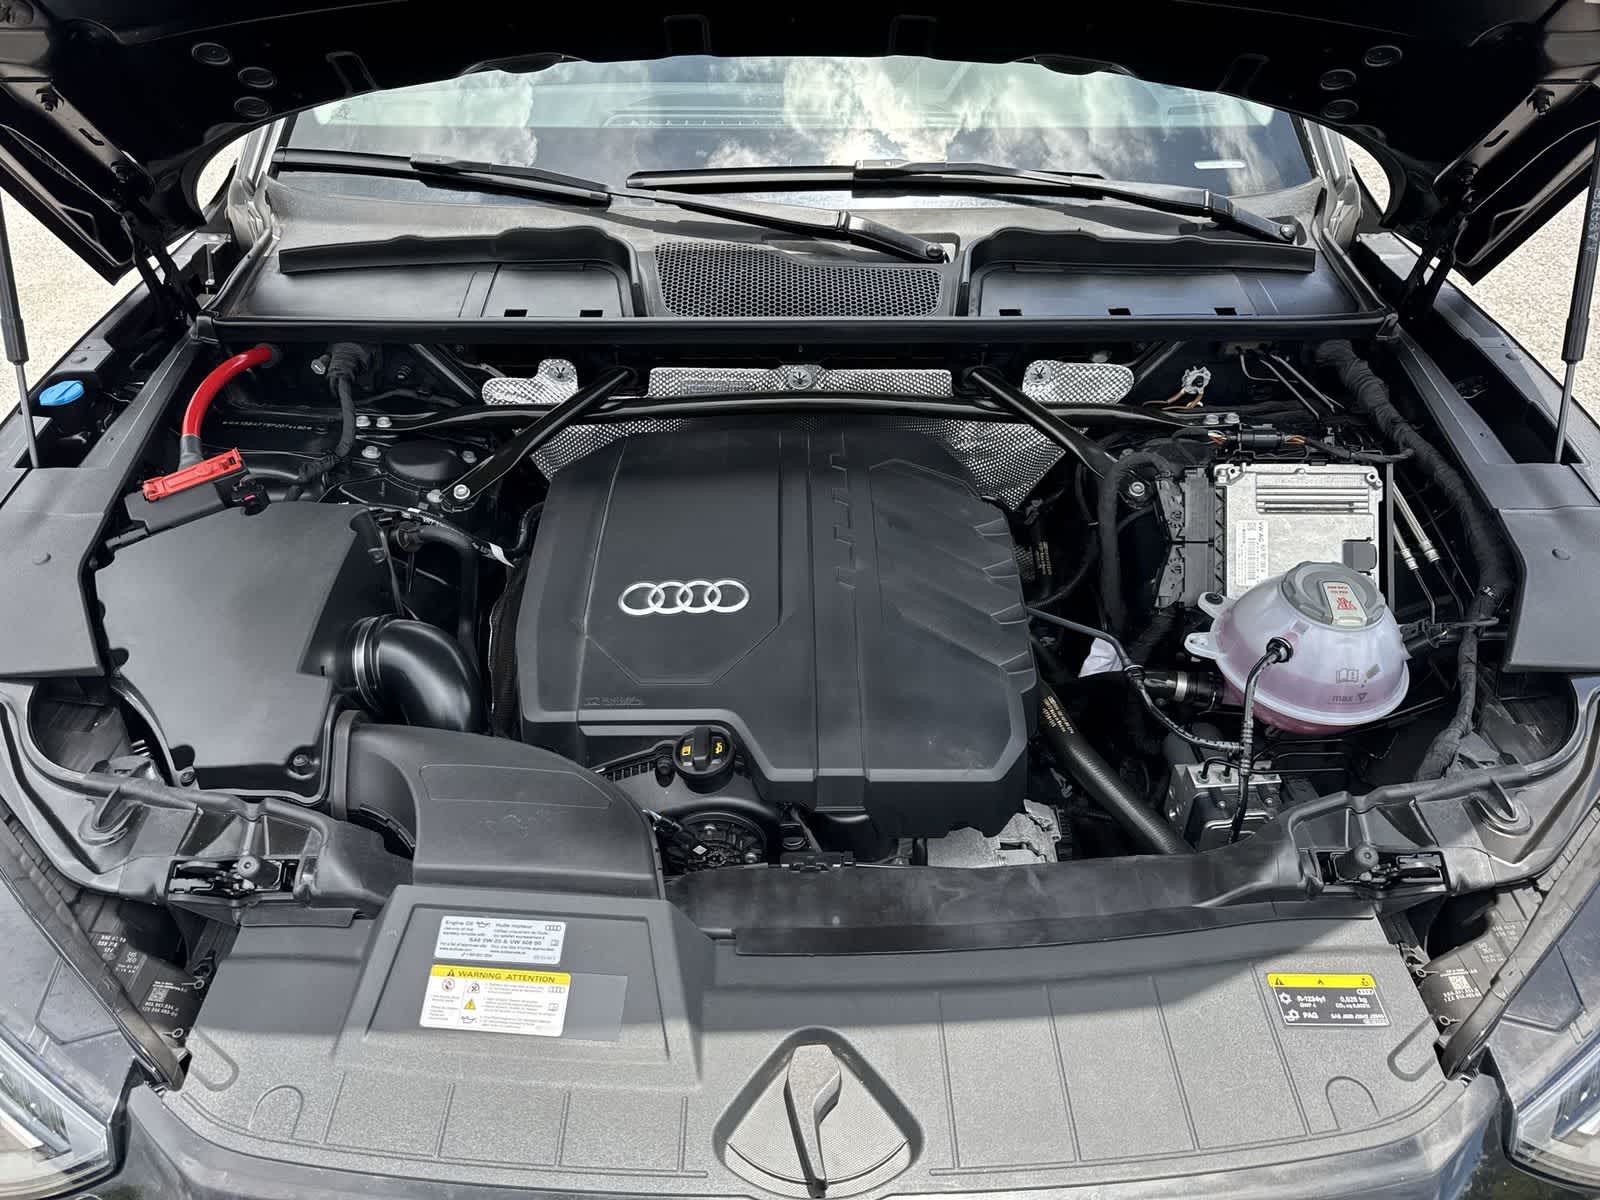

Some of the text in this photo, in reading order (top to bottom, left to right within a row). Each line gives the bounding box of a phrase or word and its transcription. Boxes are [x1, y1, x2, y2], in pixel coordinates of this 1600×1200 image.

[1332, 695, 1354, 703] max
[458, 970, 556, 983] WARNING ATTENTION
